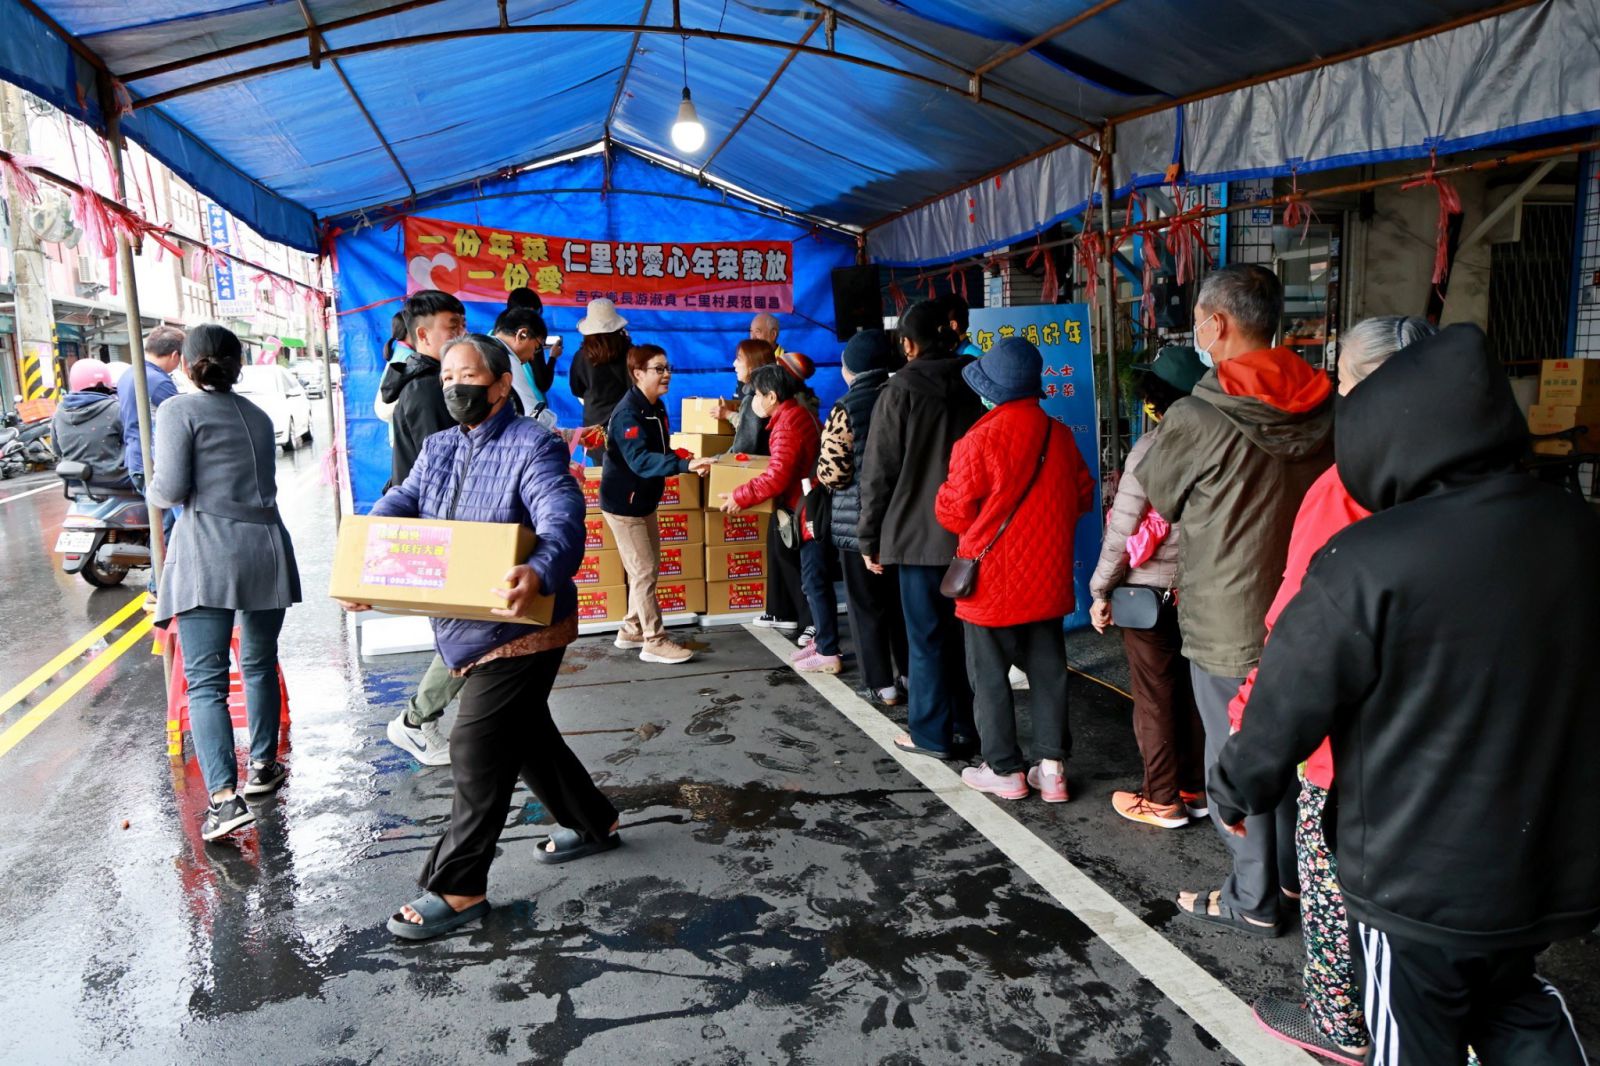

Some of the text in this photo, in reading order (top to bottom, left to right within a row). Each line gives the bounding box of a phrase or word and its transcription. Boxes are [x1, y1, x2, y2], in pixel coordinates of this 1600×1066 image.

[416, 228, 550, 263] 一份年菜
[561, 240, 789, 282] 仁里村愛心年菜發放
[467, 262, 564, 295] 一份愛
